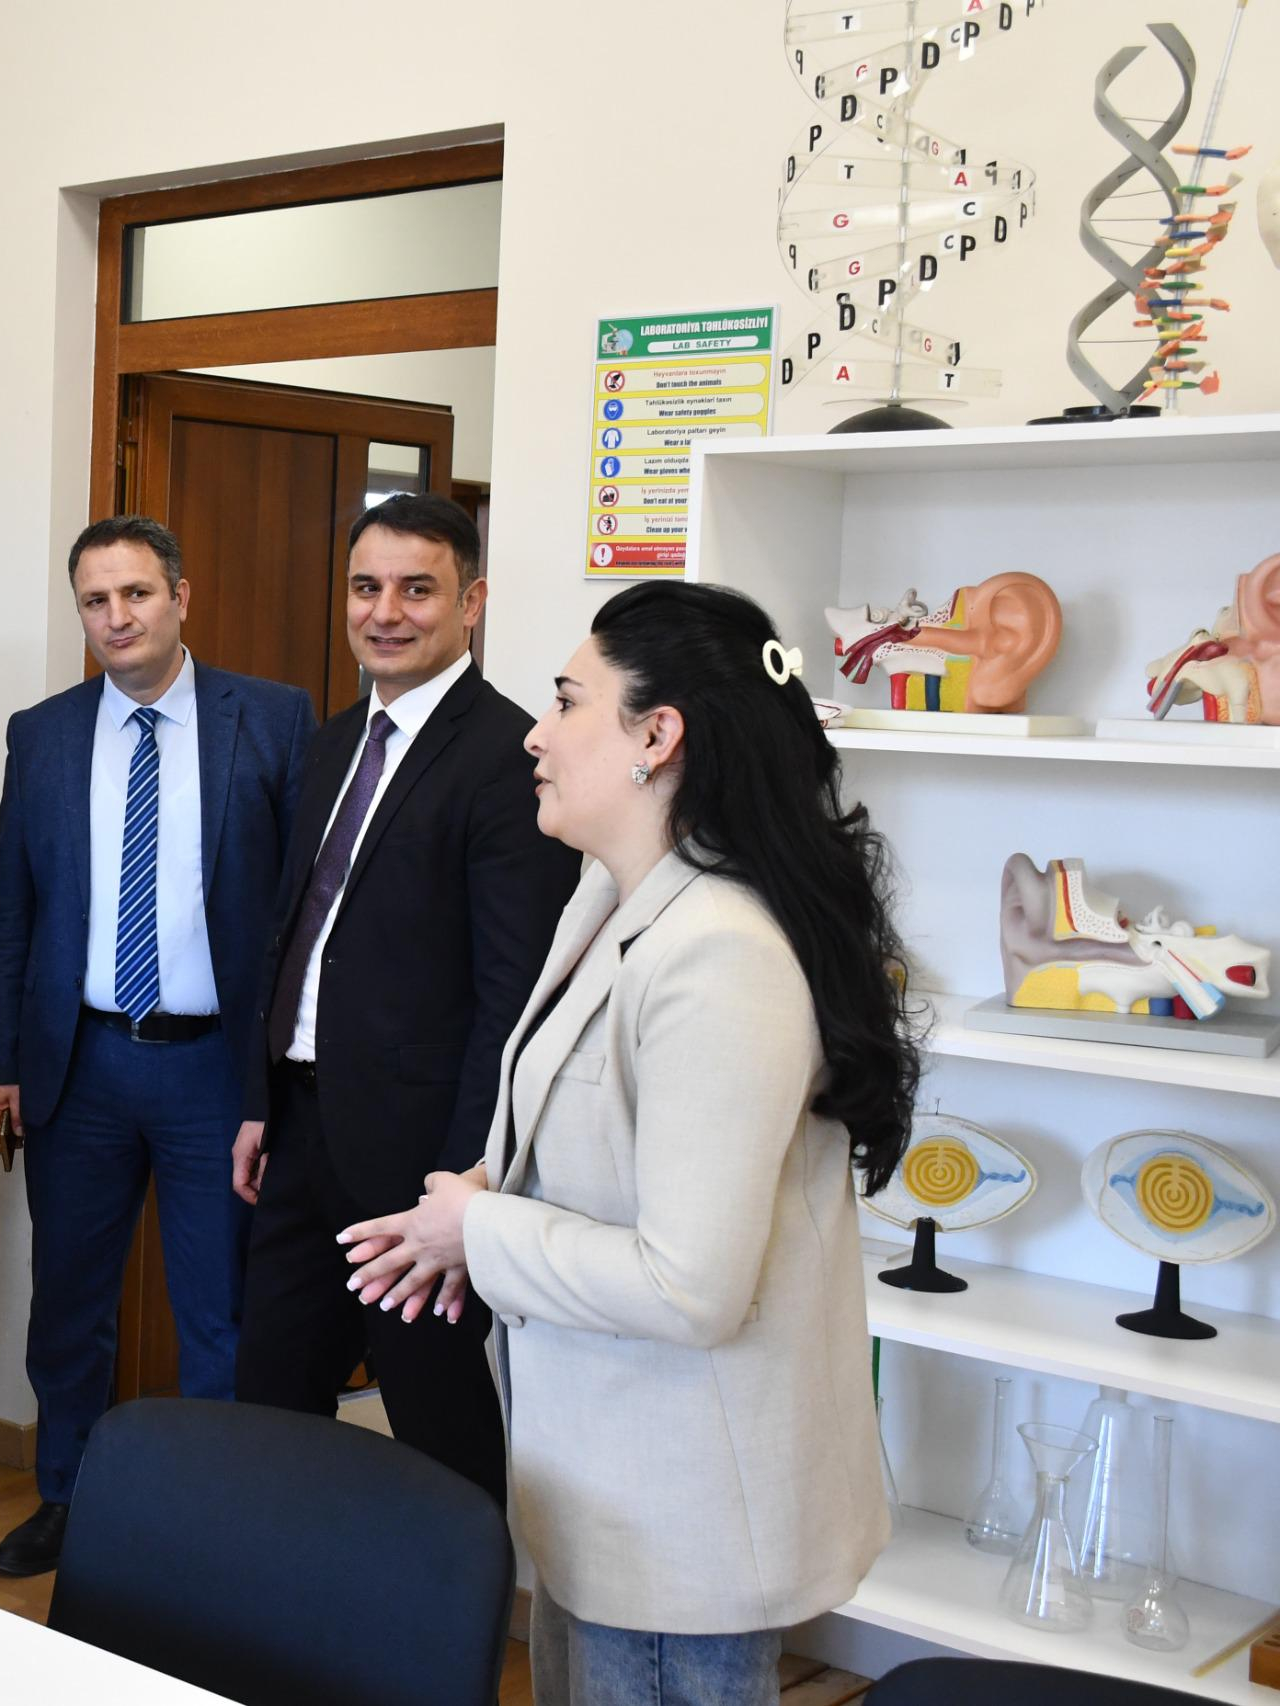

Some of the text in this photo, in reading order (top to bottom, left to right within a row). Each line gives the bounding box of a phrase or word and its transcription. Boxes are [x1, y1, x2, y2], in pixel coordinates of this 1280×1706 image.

[842, 15, 853, 30] T
[999, 3, 1012, 31] D
[963, 21, 980, 48] P
[921, 42, 940, 69] D
[880, 67, 898, 95] P
[840, 94, 857, 122] D
[876, 114, 883, 129] C
[809, 124, 822, 152] P
[931, 141, 939, 156] G
[787, 155, 795, 183] D
[844, 164, 854, 179] T
[954, 171, 968, 186] A
[962, 201, 976, 216] C
[1019, 202, 1027, 228] P
[832, 213, 849, 228] G
[994, 216, 1007, 243] D
[944, 235, 954, 250] C
[959, 235, 976, 261] P
[848, 261, 861, 275] G
[920, 255, 937, 281] D
[878, 279, 896, 306] P
[839, 304, 856, 331] D
[872, 319, 878, 333] C
[672, 339, 732, 350] LAB SAFETY
[807, 333, 821, 359] P
[924, 338, 932, 352] G
[782, 358, 793, 385] D
[836, 366, 850, 381] A
[688, 379, 698, 387] the
[944, 373, 955, 388] T
[659, 409, 673, 417] Wear
[674, 408, 692, 417] safety
